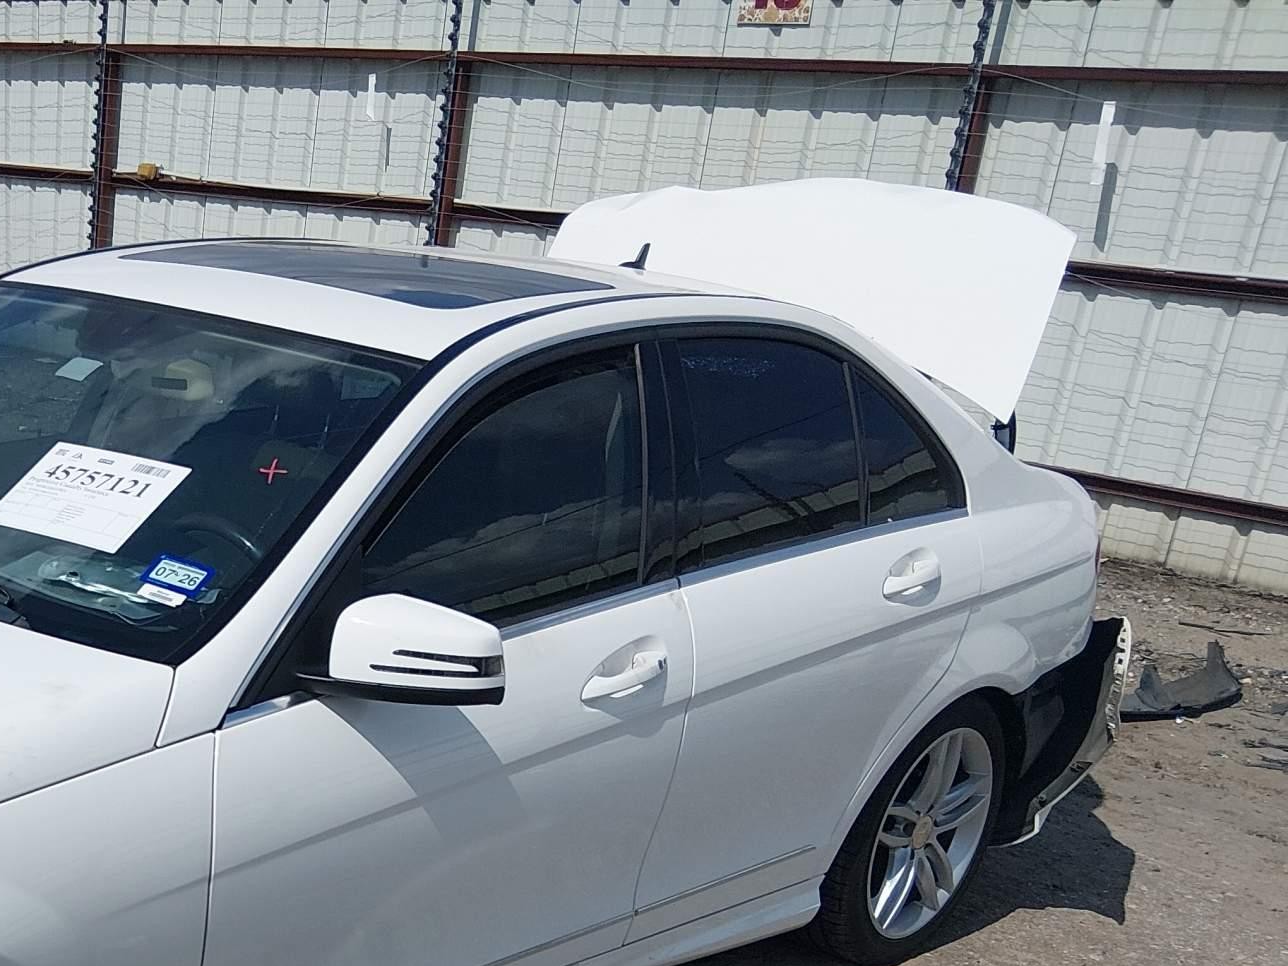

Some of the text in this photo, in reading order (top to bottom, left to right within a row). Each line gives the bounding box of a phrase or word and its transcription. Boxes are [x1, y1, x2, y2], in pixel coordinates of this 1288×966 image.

[44, 463, 153, 498] 45757121
[155, 566, 176, 579] 07
[177, 573, 200, 587] 26
